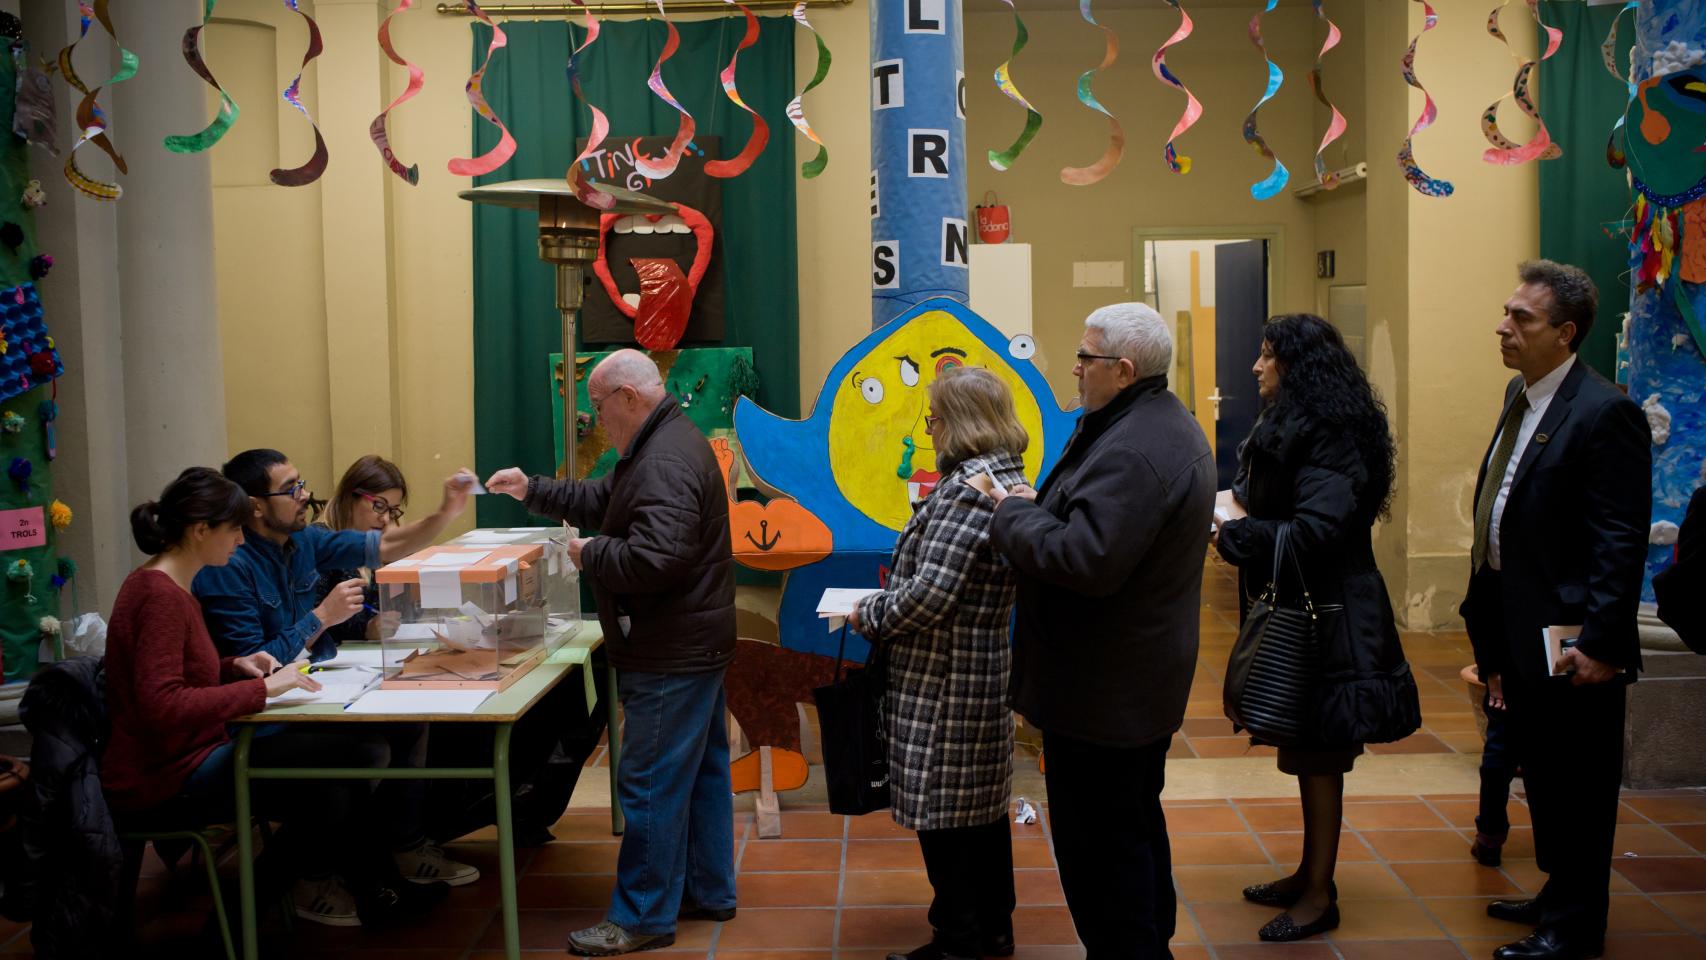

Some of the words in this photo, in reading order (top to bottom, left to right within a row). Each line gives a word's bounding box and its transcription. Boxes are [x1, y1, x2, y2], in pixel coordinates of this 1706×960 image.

[909, 0, 939, 30] L
[873, 63, 899, 105] T
[912, 134, 948, 174] R
[945, 223, 968, 264] N
[873, 245, 895, 286] S
[10, 528, 38, 539] TROLS
